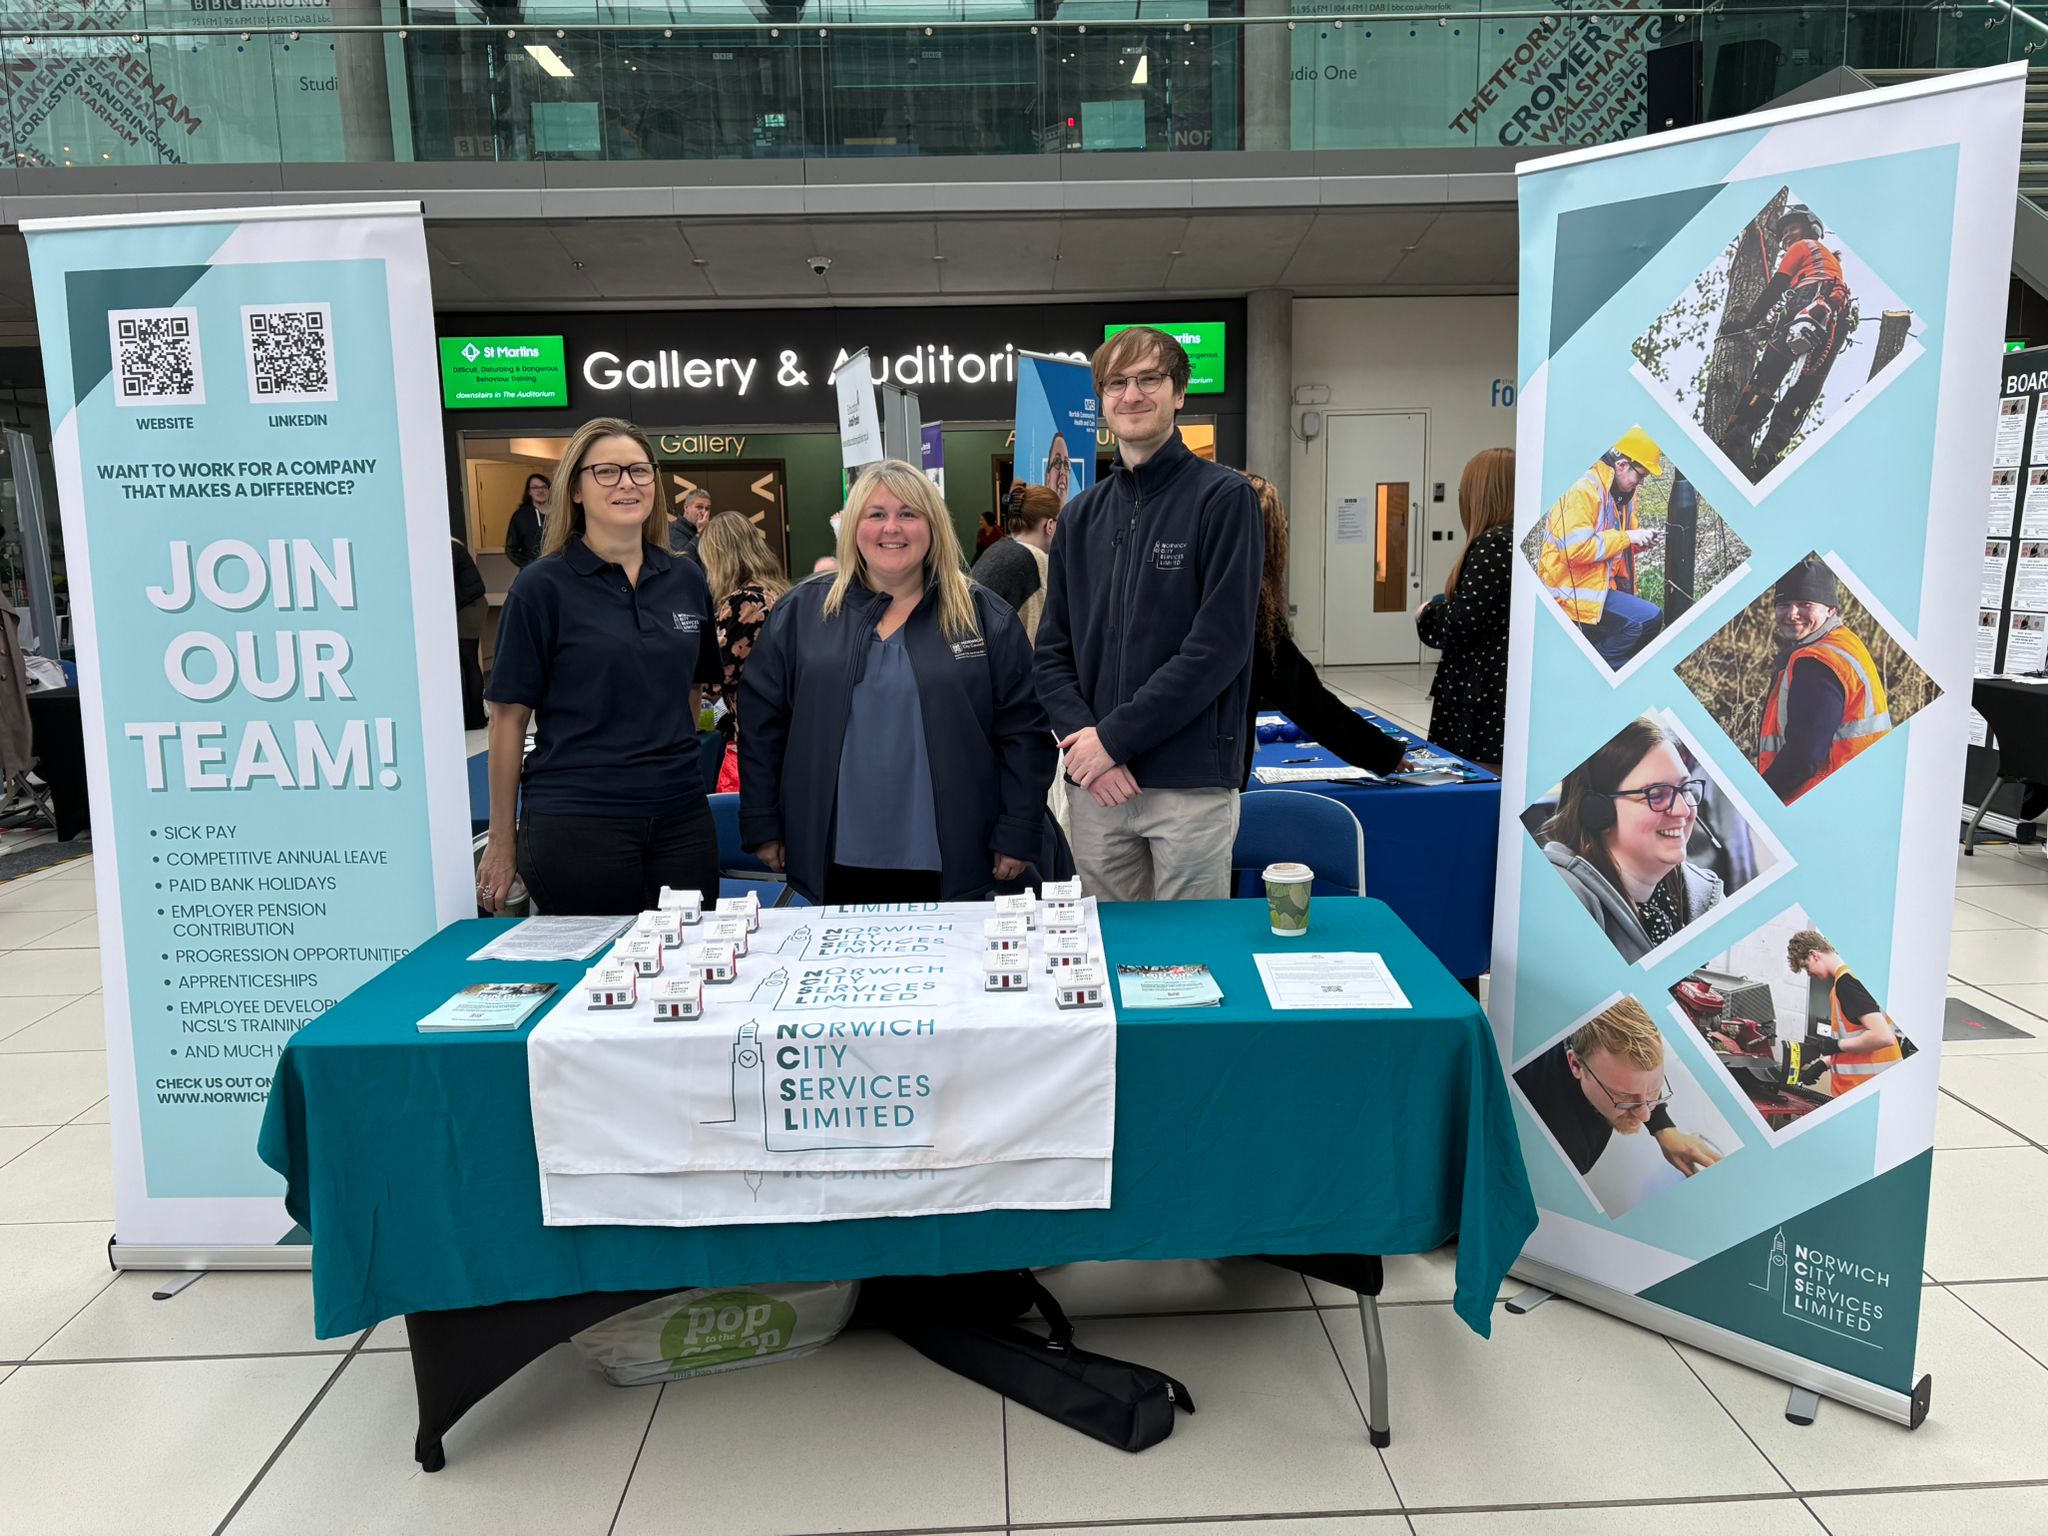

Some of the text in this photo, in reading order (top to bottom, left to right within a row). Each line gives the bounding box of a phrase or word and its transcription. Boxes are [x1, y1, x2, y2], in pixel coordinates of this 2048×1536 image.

[1520, 26, 1577, 86] WELLS
[1324, 65, 1357, 80] One
[300, 76, 338, 91] Studi
[1499, 26, 1611, 146] CROMER
[1558, 43, 1648, 144] MUNDESLEY
[15, 61, 86, 144] GORLESTON
[74, 85, 139, 147] MARHAM
[483, 346, 540, 358] St Martins
[522, 364, 558, 373] Dangerous
[583, 349, 757, 397] Gallery
[777, 349, 810, 387] &
[456, 391, 493, 399] downstairs
[517, 390, 555, 398] Auditorium
[1491, 378, 1518, 407] fo
[136, 417, 194, 430] WEBSITE
[268, 414, 327, 428] LINKEDIN
[660, 435, 746, 457] Gallery
[97, 459, 377, 479] WANT TO WORK FOR A COMPANY
[122, 480, 355, 498] THAT MAKES A DIFFERENCE?
[145, 538, 358, 614] JOIN
[164, 630, 358, 704] OUR
[124, 717, 402, 792] TEAM!
[164, 825, 236, 839] SICK PAY
[166, 850, 388, 866] COMPETITIVE ANNUAL LEAVE
[169, 876, 337, 892] PAID BANK HOLIDAYS
[172, 903, 327, 918] EMPLOYER PENSION
[838, 902, 939, 913] LIMITED
[173, 922, 294, 937] CONTRIBUTION
[825, 924, 953, 935] NORWICH
[820, 937, 945, 948] SERVICES
[821, 933, 881, 942] CITY
[176, 949, 289, 963] PROGRESSION
[818, 945, 929, 956] LIMITED
[803, 965, 944, 977] NORWICH
[179, 974, 318, 989] APPRENTICESHIPS
[797, 981, 936, 995] SERVICES
[799, 975, 864, 986] CITY
[795, 992, 918, 1005] LIMITED
[181, 1000, 260, 1015] EMPLOYEE
[776, 1019, 935, 1040] NORWICH
[185, 1045, 220, 1058] AND
[224, 1044, 273, 1058] MUCH
[776, 1044, 847, 1070] CITY
[156, 1079, 201, 1089] CHECK
[205, 1078, 221, 1088] US
[225, 1078, 252, 1088] OUT
[780, 1074, 931, 1102] SERVICES
[784, 1105, 915, 1131] LIMITED
[1794, 1261, 1836, 1286] CITY
[1795, 1244, 1890, 1288] NORWICH
[1794, 1278, 1884, 1320] SERVICES
[1795, 1296, 1871, 1332] LIMITED
[683, 1304, 772, 1345] pop
[705, 1333, 737, 1343] to the
